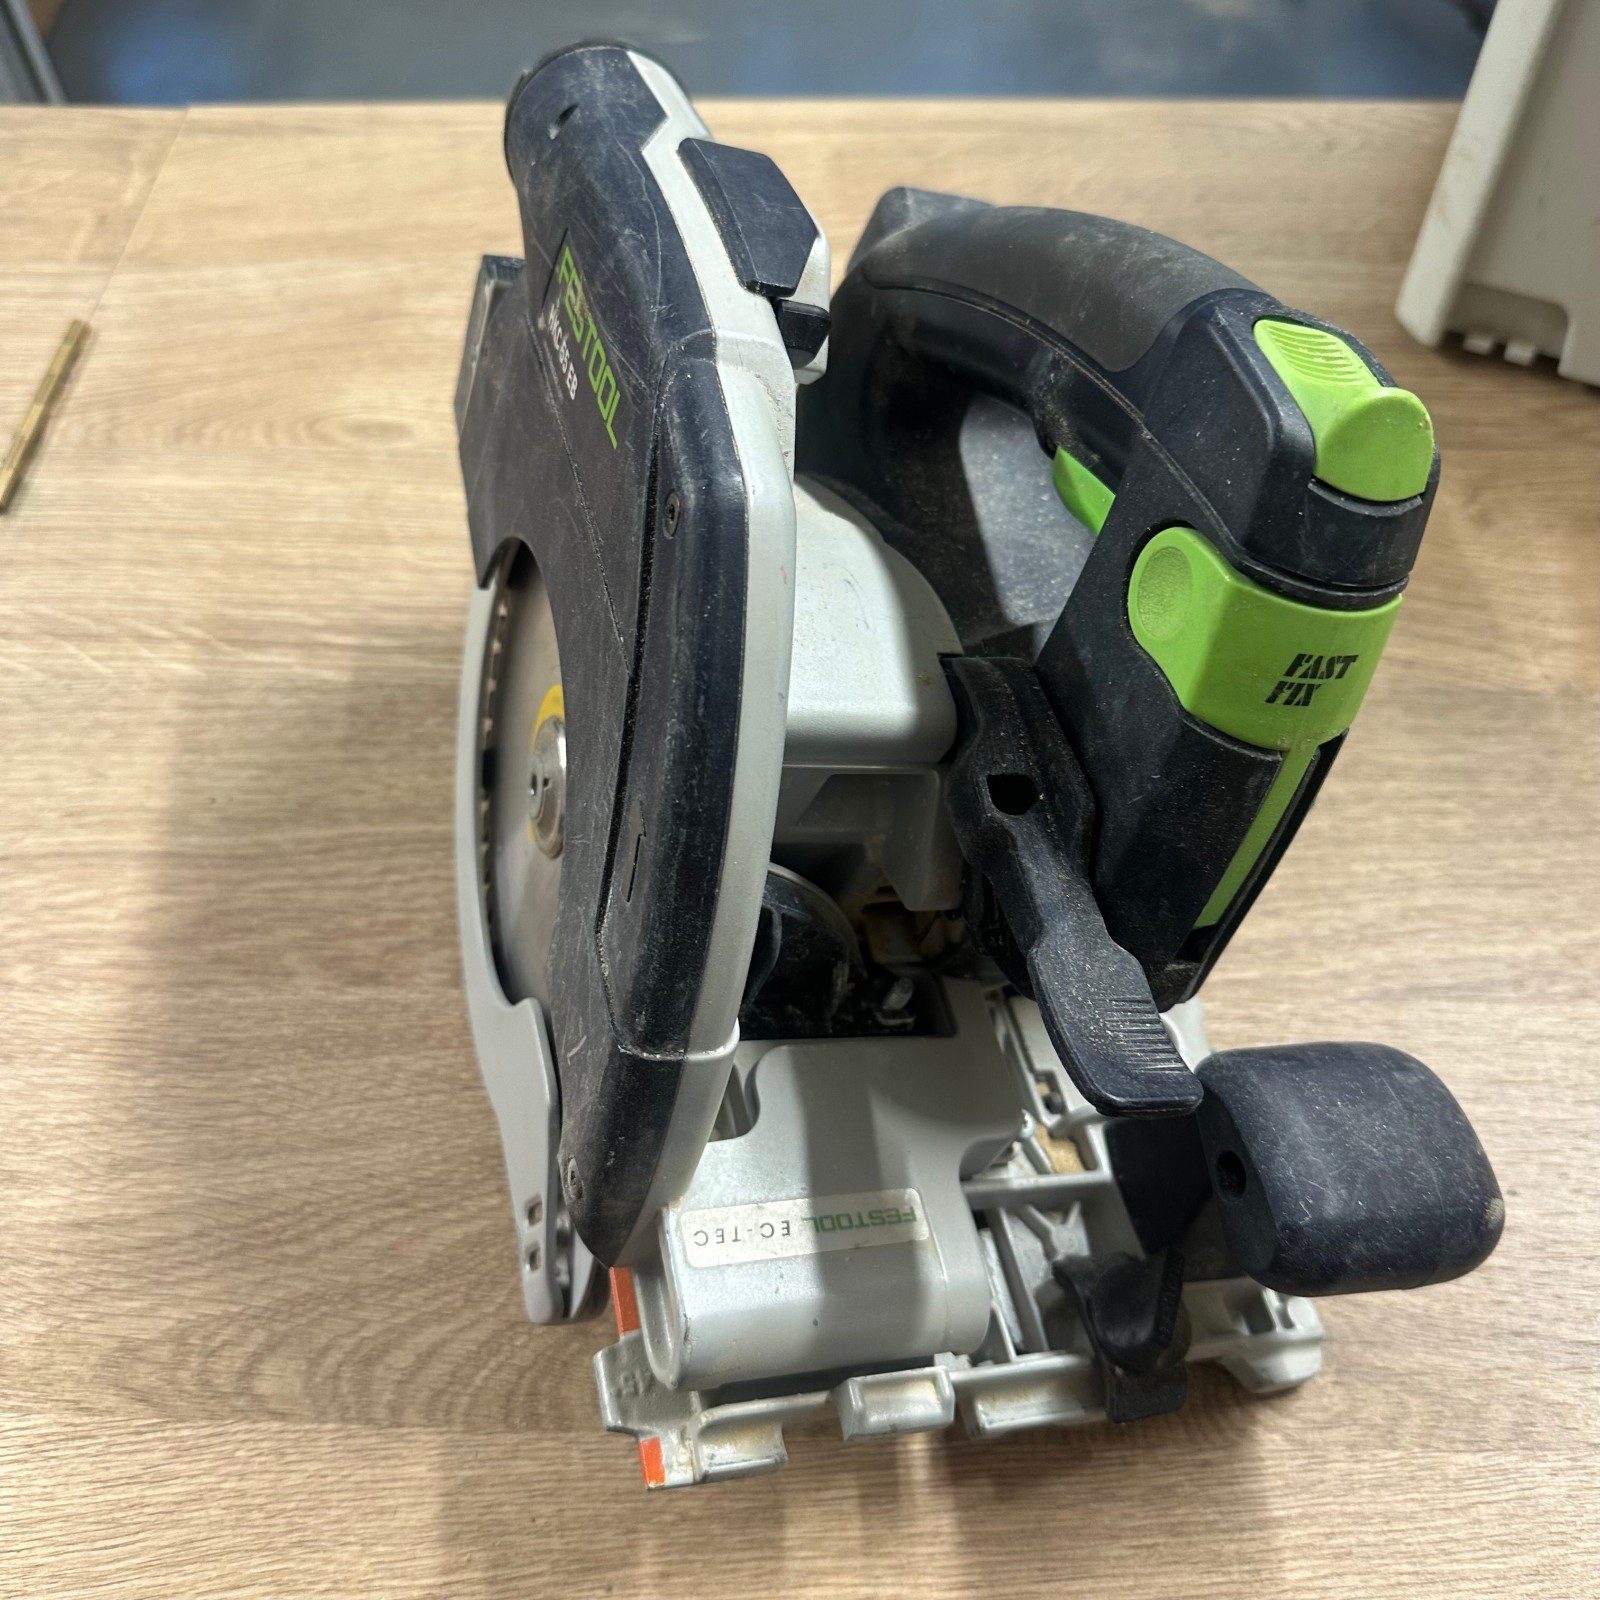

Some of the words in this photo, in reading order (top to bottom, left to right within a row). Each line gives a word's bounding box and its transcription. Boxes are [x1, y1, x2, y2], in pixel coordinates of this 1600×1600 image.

[558, 246, 621, 450] FESTOOL
[566, 362, 578, 400] EB
[1283, 653, 1360, 679] FAST
[1265, 680, 1323, 706] FIX
[803, 1206, 918, 1233] FESTOOL
[693, 1220, 792, 1247] EC-TEC
